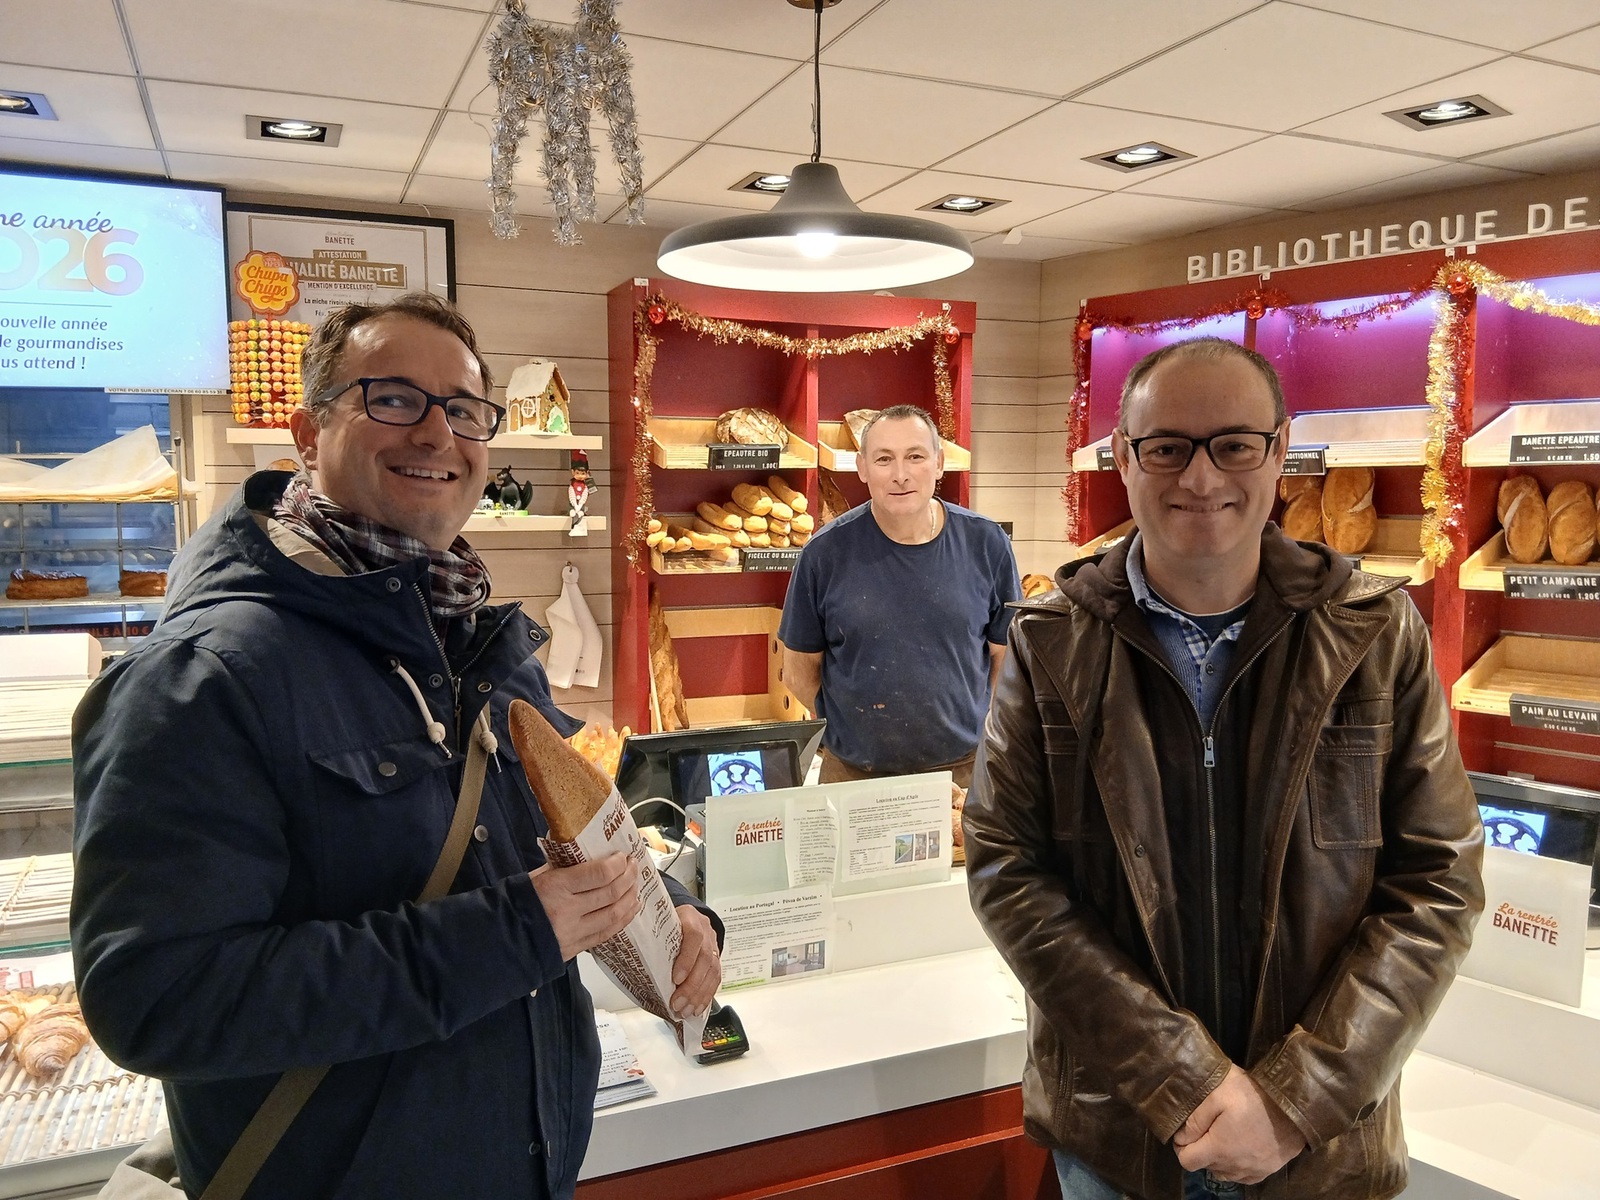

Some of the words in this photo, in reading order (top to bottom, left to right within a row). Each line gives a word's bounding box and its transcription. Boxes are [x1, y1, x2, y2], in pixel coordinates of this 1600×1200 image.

[0, 212, 25, 227] ne
[33, 211, 114, 233] année
[324, 236, 355, 246] BANETTE
[1187, 209, 1498, 283] BIBLIOTHEQUE
[1526, 196, 1589, 235] DE
[0, 227, 145, 297] 026
[318, 251, 362, 259] ATTESTATION
[246, 265, 289, 284] Chupa
[287, 260, 336, 278] UALITÉ
[339, 265, 399, 283] BANETTE
[245, 279, 288, 303] Chups
[307, 282, 332, 290] MENTION
[0, 315, 56, 330] ouvelle
[61, 317, 108, 331] année
[16, 337, 124, 352] gourmandises
[1, 360, 19, 369] us
[23, 357, 76, 370] attend
[81, 357, 86, 370] !
[1521, 436, 1556, 446] BANETTE
[1558, 434, 1600, 445] EPEAUTRE
[723, 450, 756, 458] EPEAUTRE
[757, 449, 769, 457] BIO
[1285, 452, 1320, 460] ADITIONNEL
[1583, 453, 1600, 461] 1.50
[1510, 576, 1538, 585] PETIT
[1542, 576, 1597, 587] CAMPAGNE
[1521, 706, 1544, 716] PAIN
[1547, 708, 1560, 717] AU
[1562, 710, 1598, 721] LEVAIN
[604, 798, 626, 842] BANETT
[738, 822, 750, 832] La
[752, 817, 782, 829] rentrée
[735, 828, 783, 846] BANETTE
[1498, 903, 1514, 915] La
[1517, 910, 1557, 928] rentrée
[1493, 912, 1558, 946] BANETTE
